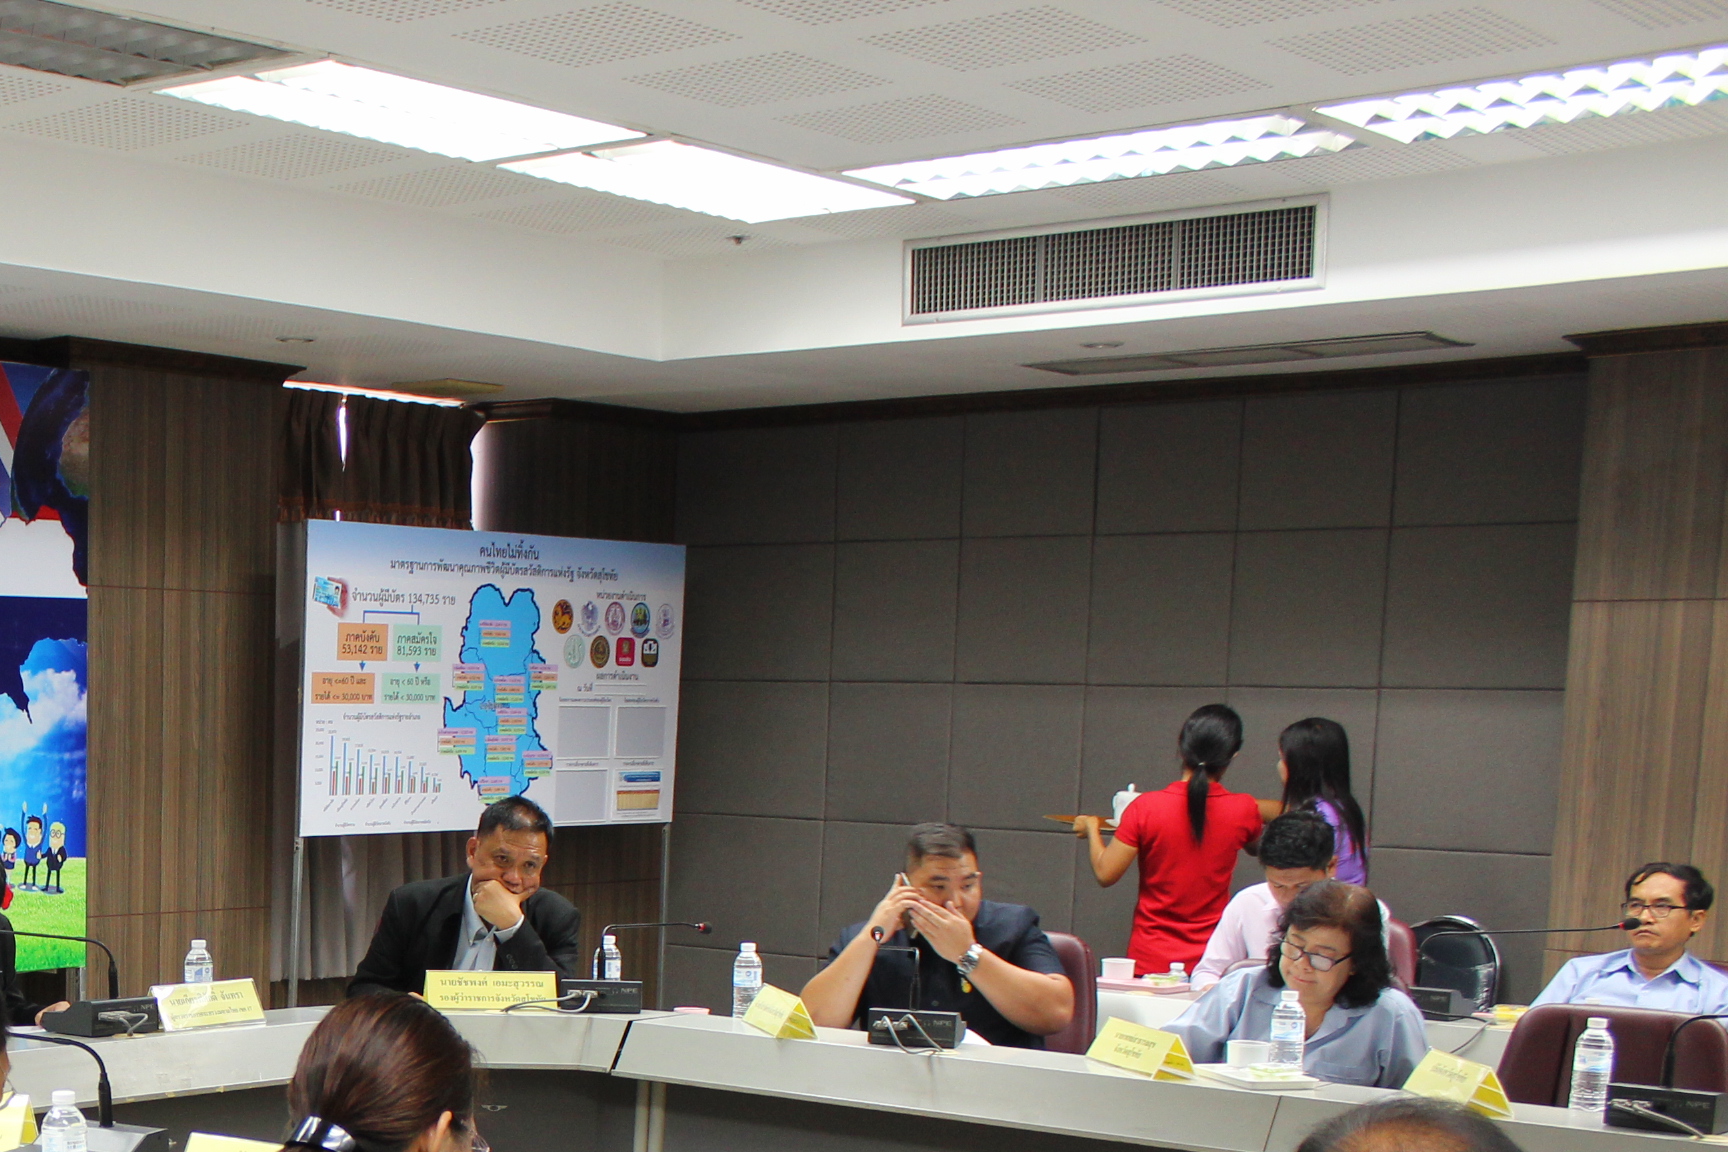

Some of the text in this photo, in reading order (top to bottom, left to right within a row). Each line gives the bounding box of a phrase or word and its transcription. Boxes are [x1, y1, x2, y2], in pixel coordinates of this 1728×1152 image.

[479, 540, 540, 560] คนไทยไม่ทิ้งกัน
[408, 593, 440, 606] 134,735
[442, 596, 456, 605] ราย
[345, 630, 380, 643] ภาคบังคับ
[397, 632, 437, 645] ภาคสมัครใจ
[342, 645, 383, 655] 53,142 ราย
[397, 646, 436, 656] 81,593 ราย
[440, 992, 546, 1004] รองผู้ว่าราชการจังหวัดสโขทัย
